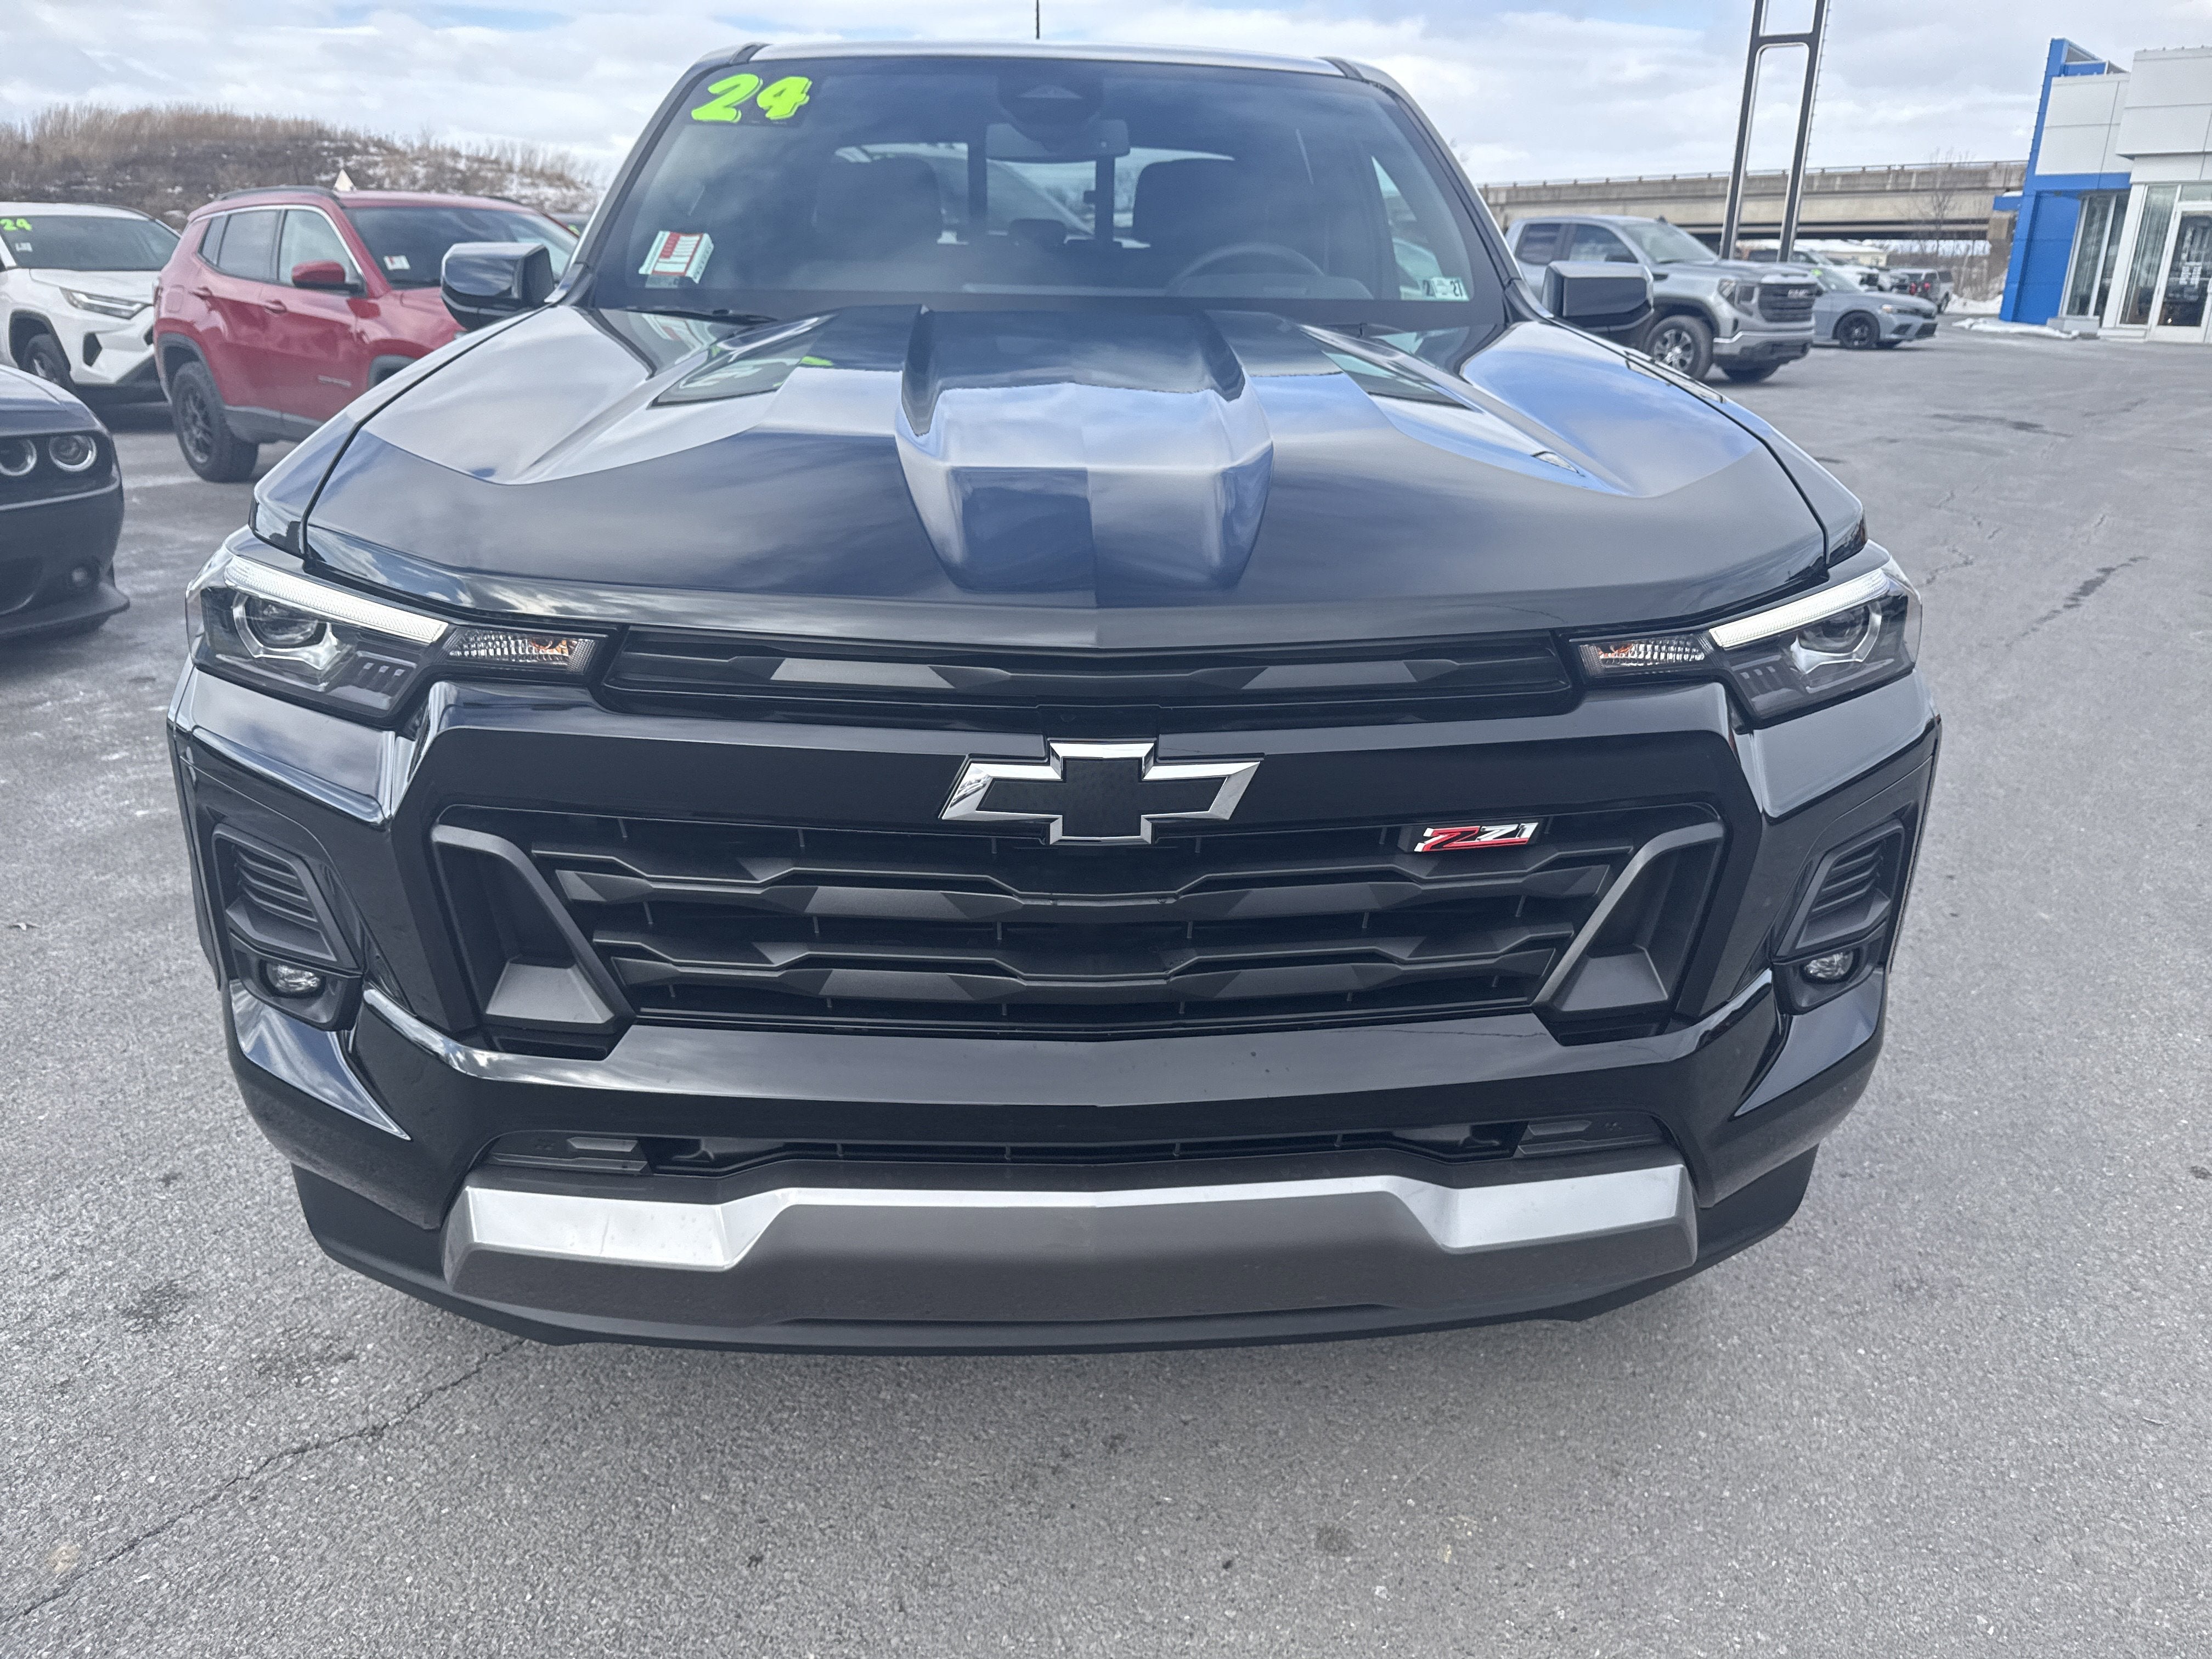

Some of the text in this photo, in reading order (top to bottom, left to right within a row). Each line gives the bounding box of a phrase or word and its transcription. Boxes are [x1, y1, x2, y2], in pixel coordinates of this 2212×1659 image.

[691, 73, 812, 122] 24
[0, 218, 32, 231] 24
[1414, 822, 1538, 852] Z71
